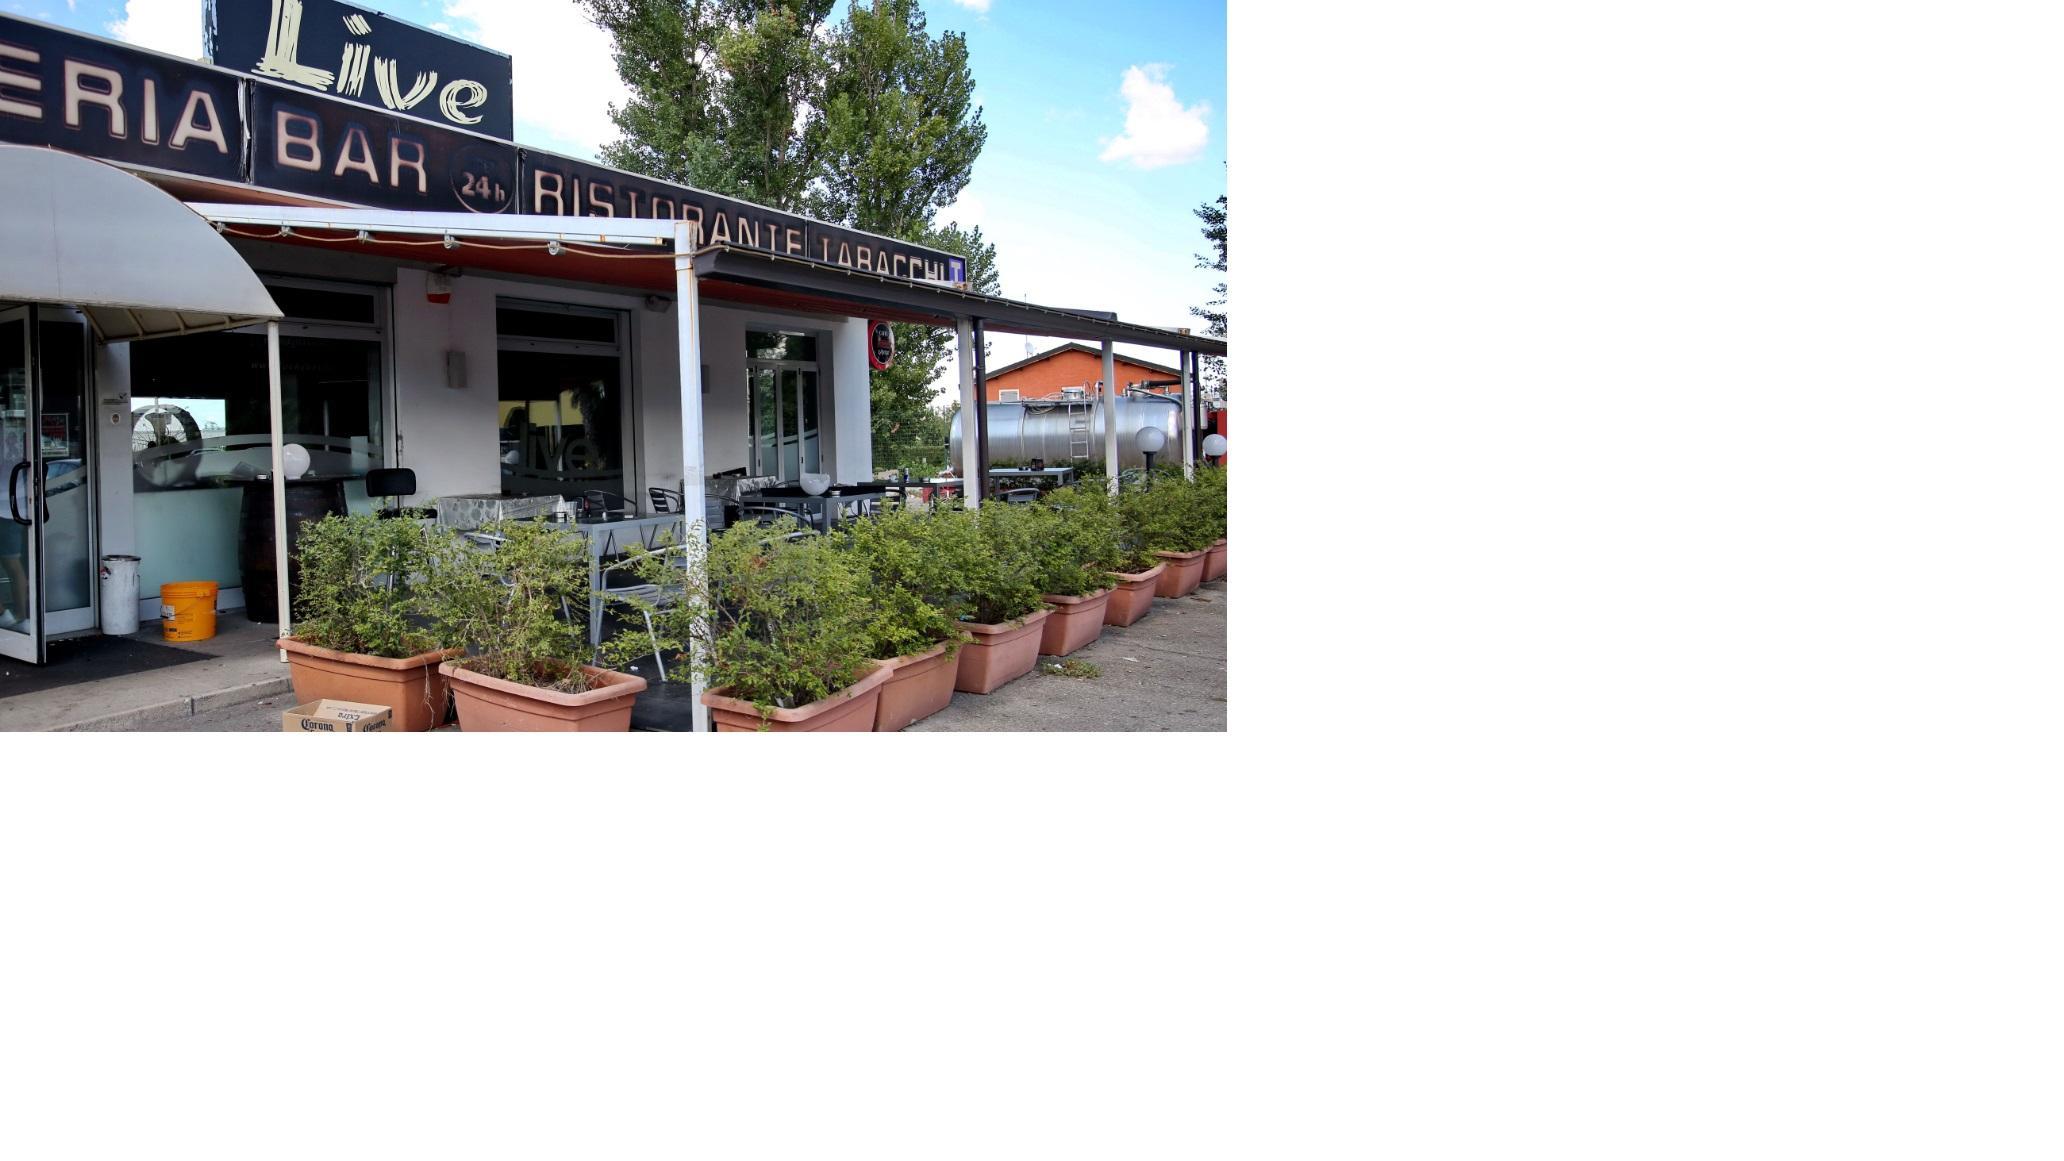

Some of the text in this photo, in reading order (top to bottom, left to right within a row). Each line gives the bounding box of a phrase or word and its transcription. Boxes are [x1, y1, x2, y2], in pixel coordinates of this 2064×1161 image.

[252, 0, 488, 125] Live
[277, 111, 427, 193] BAR
[301, 718, 334, 732] Corona
